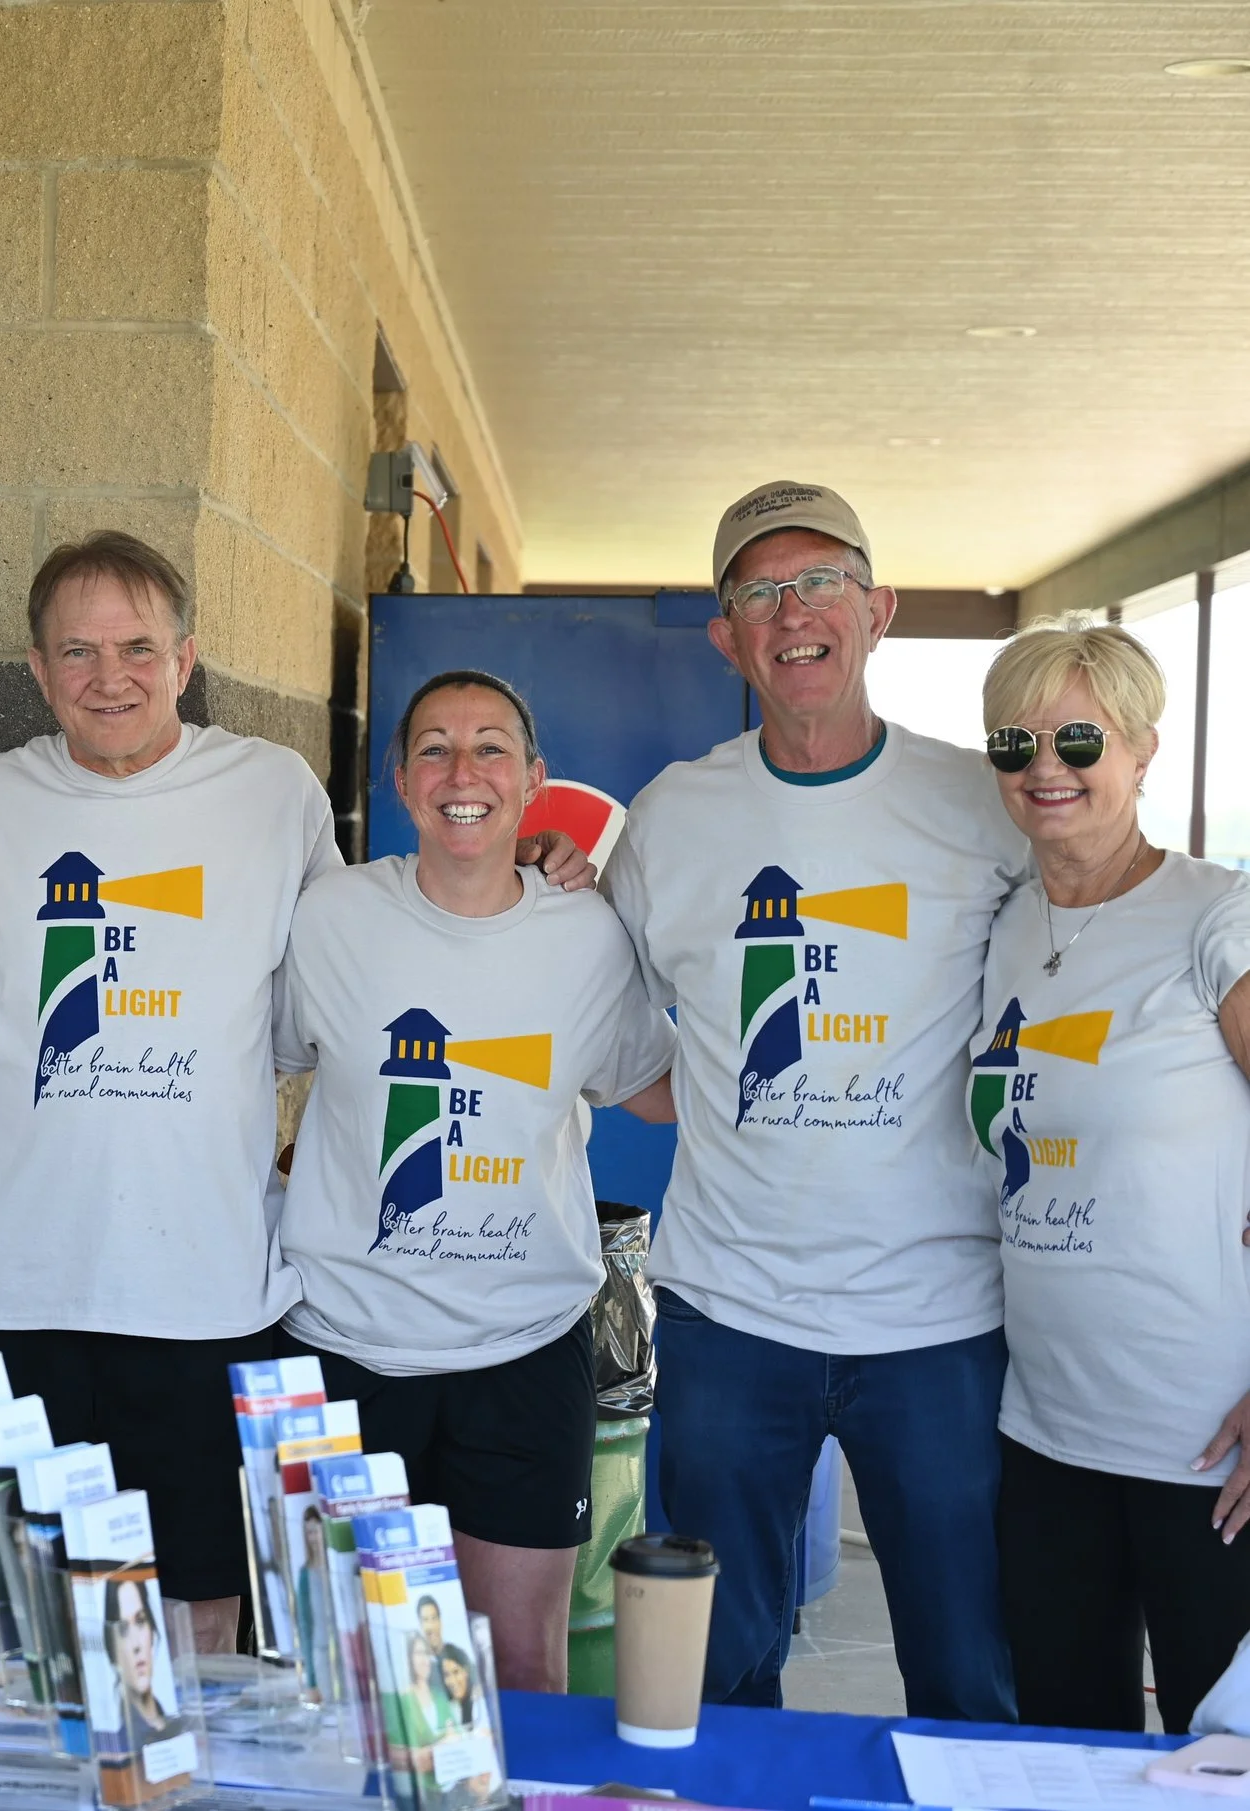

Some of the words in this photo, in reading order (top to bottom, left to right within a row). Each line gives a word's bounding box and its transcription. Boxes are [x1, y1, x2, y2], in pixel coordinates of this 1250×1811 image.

[780, 495, 813, 503] ISLAND
[104, 926, 136, 952] BE
[102, 956, 119, 982] A
[804, 944, 838, 972] BE
[105, 989, 182, 1017] LIGHT
[803, 977, 821, 1005] A
[807, 1012, 889, 1043] LIGHT
[40, 1046, 82, 1077] better
[90, 1046, 134, 1073] brain
[138, 1046, 198, 1077] health
[40, 1084, 55, 1100] in
[58, 1075, 100, 1099] rural
[99, 1078, 192, 1102] communities
[742, 1071, 786, 1102] better
[793, 1073, 840, 1102] brain
[845, 1072, 905, 1103] health
[1011, 1073, 1038, 1101] BE
[449, 1087, 483, 1117] BE
[743, 1109, 758, 1124] in
[762, 1104, 804, 1129] rural
[803, 1105, 902, 1130] communities
[1012, 1107, 1028, 1134] A
[446, 1120, 463, 1147] A
[1026, 1138, 1078, 1168] LIGHT
[449, 1154, 525, 1185] LIGHT
[382, 1203, 424, 1236] better
[432, 1211, 474, 1239] brain
[479, 1212, 537, 1240] health
[1015, 1194, 1041, 1225] brain
[1045, 1197, 1096, 1228] health
[378, 1238, 393, 1252] in
[396, 1238, 441, 1261] rural
[439, 1241, 527, 1262] communities
[1018, 1230, 1094, 1253] communities
